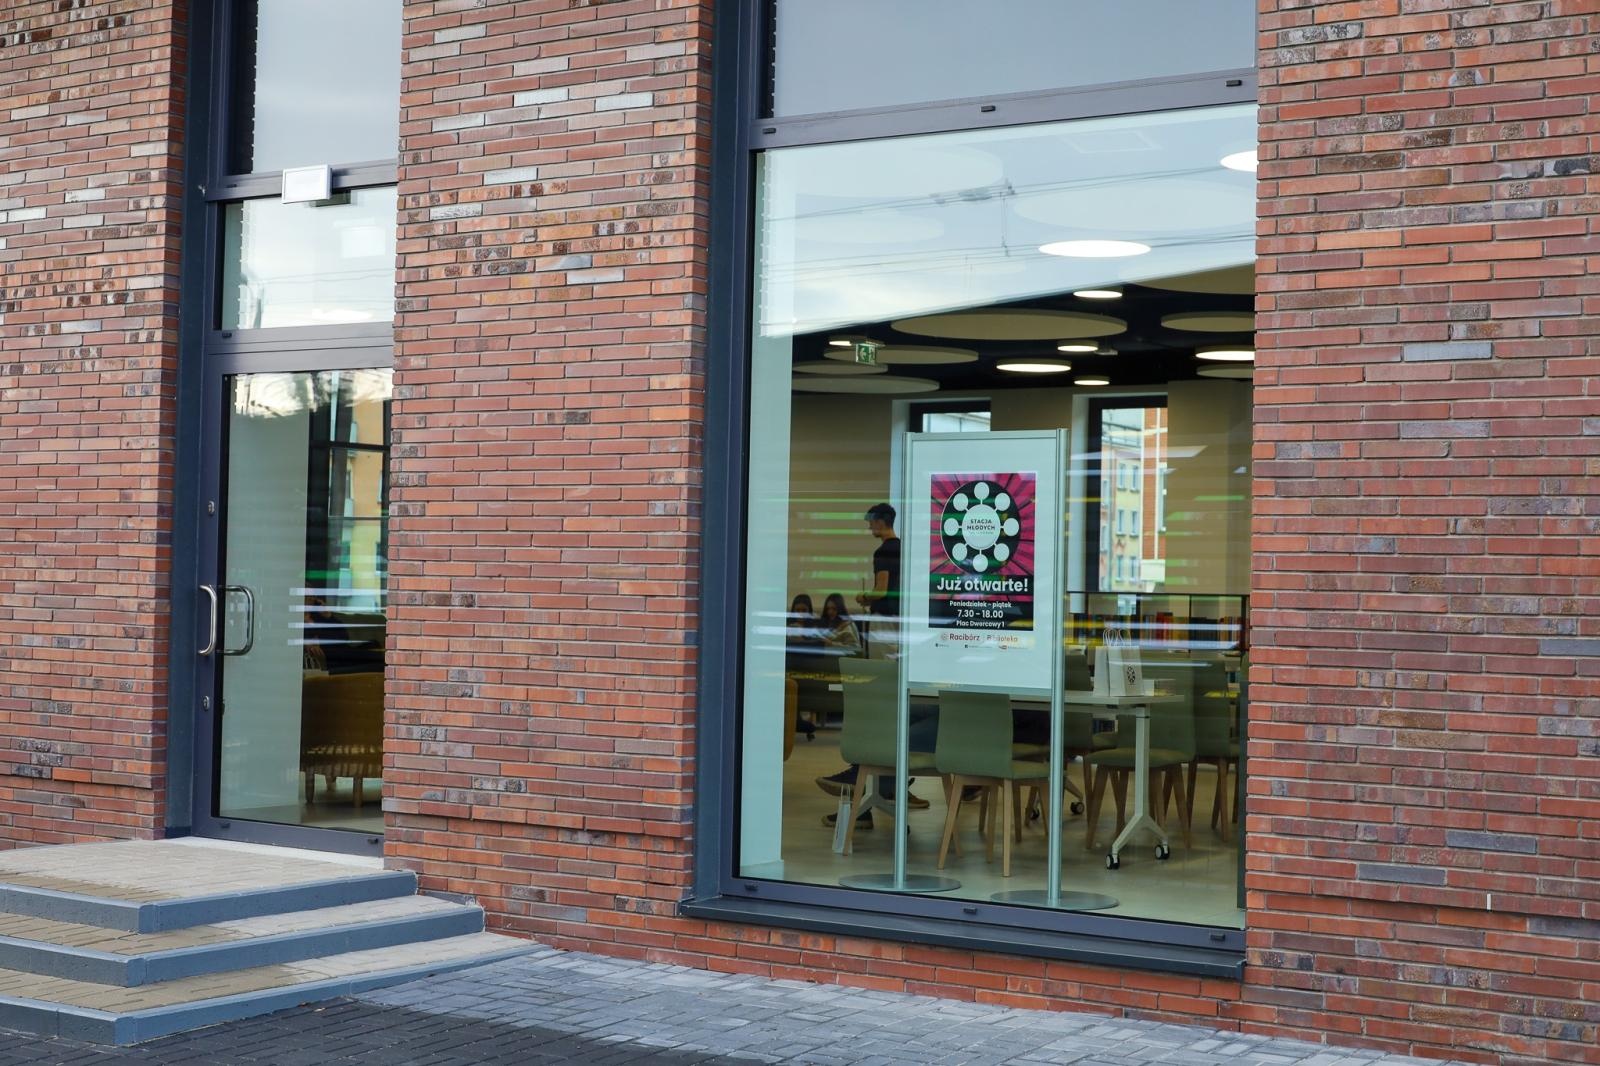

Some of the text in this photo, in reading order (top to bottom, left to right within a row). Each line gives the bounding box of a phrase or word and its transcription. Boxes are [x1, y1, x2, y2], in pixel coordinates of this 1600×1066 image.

[937, 577, 1028, 592] Już otwarte!
[957, 609, 975, 618] 7.30
[982, 610, 1004, 618] 18.00
[970, 621, 1001, 629] Dworcowy
[949, 633, 980, 641] Racibórz
